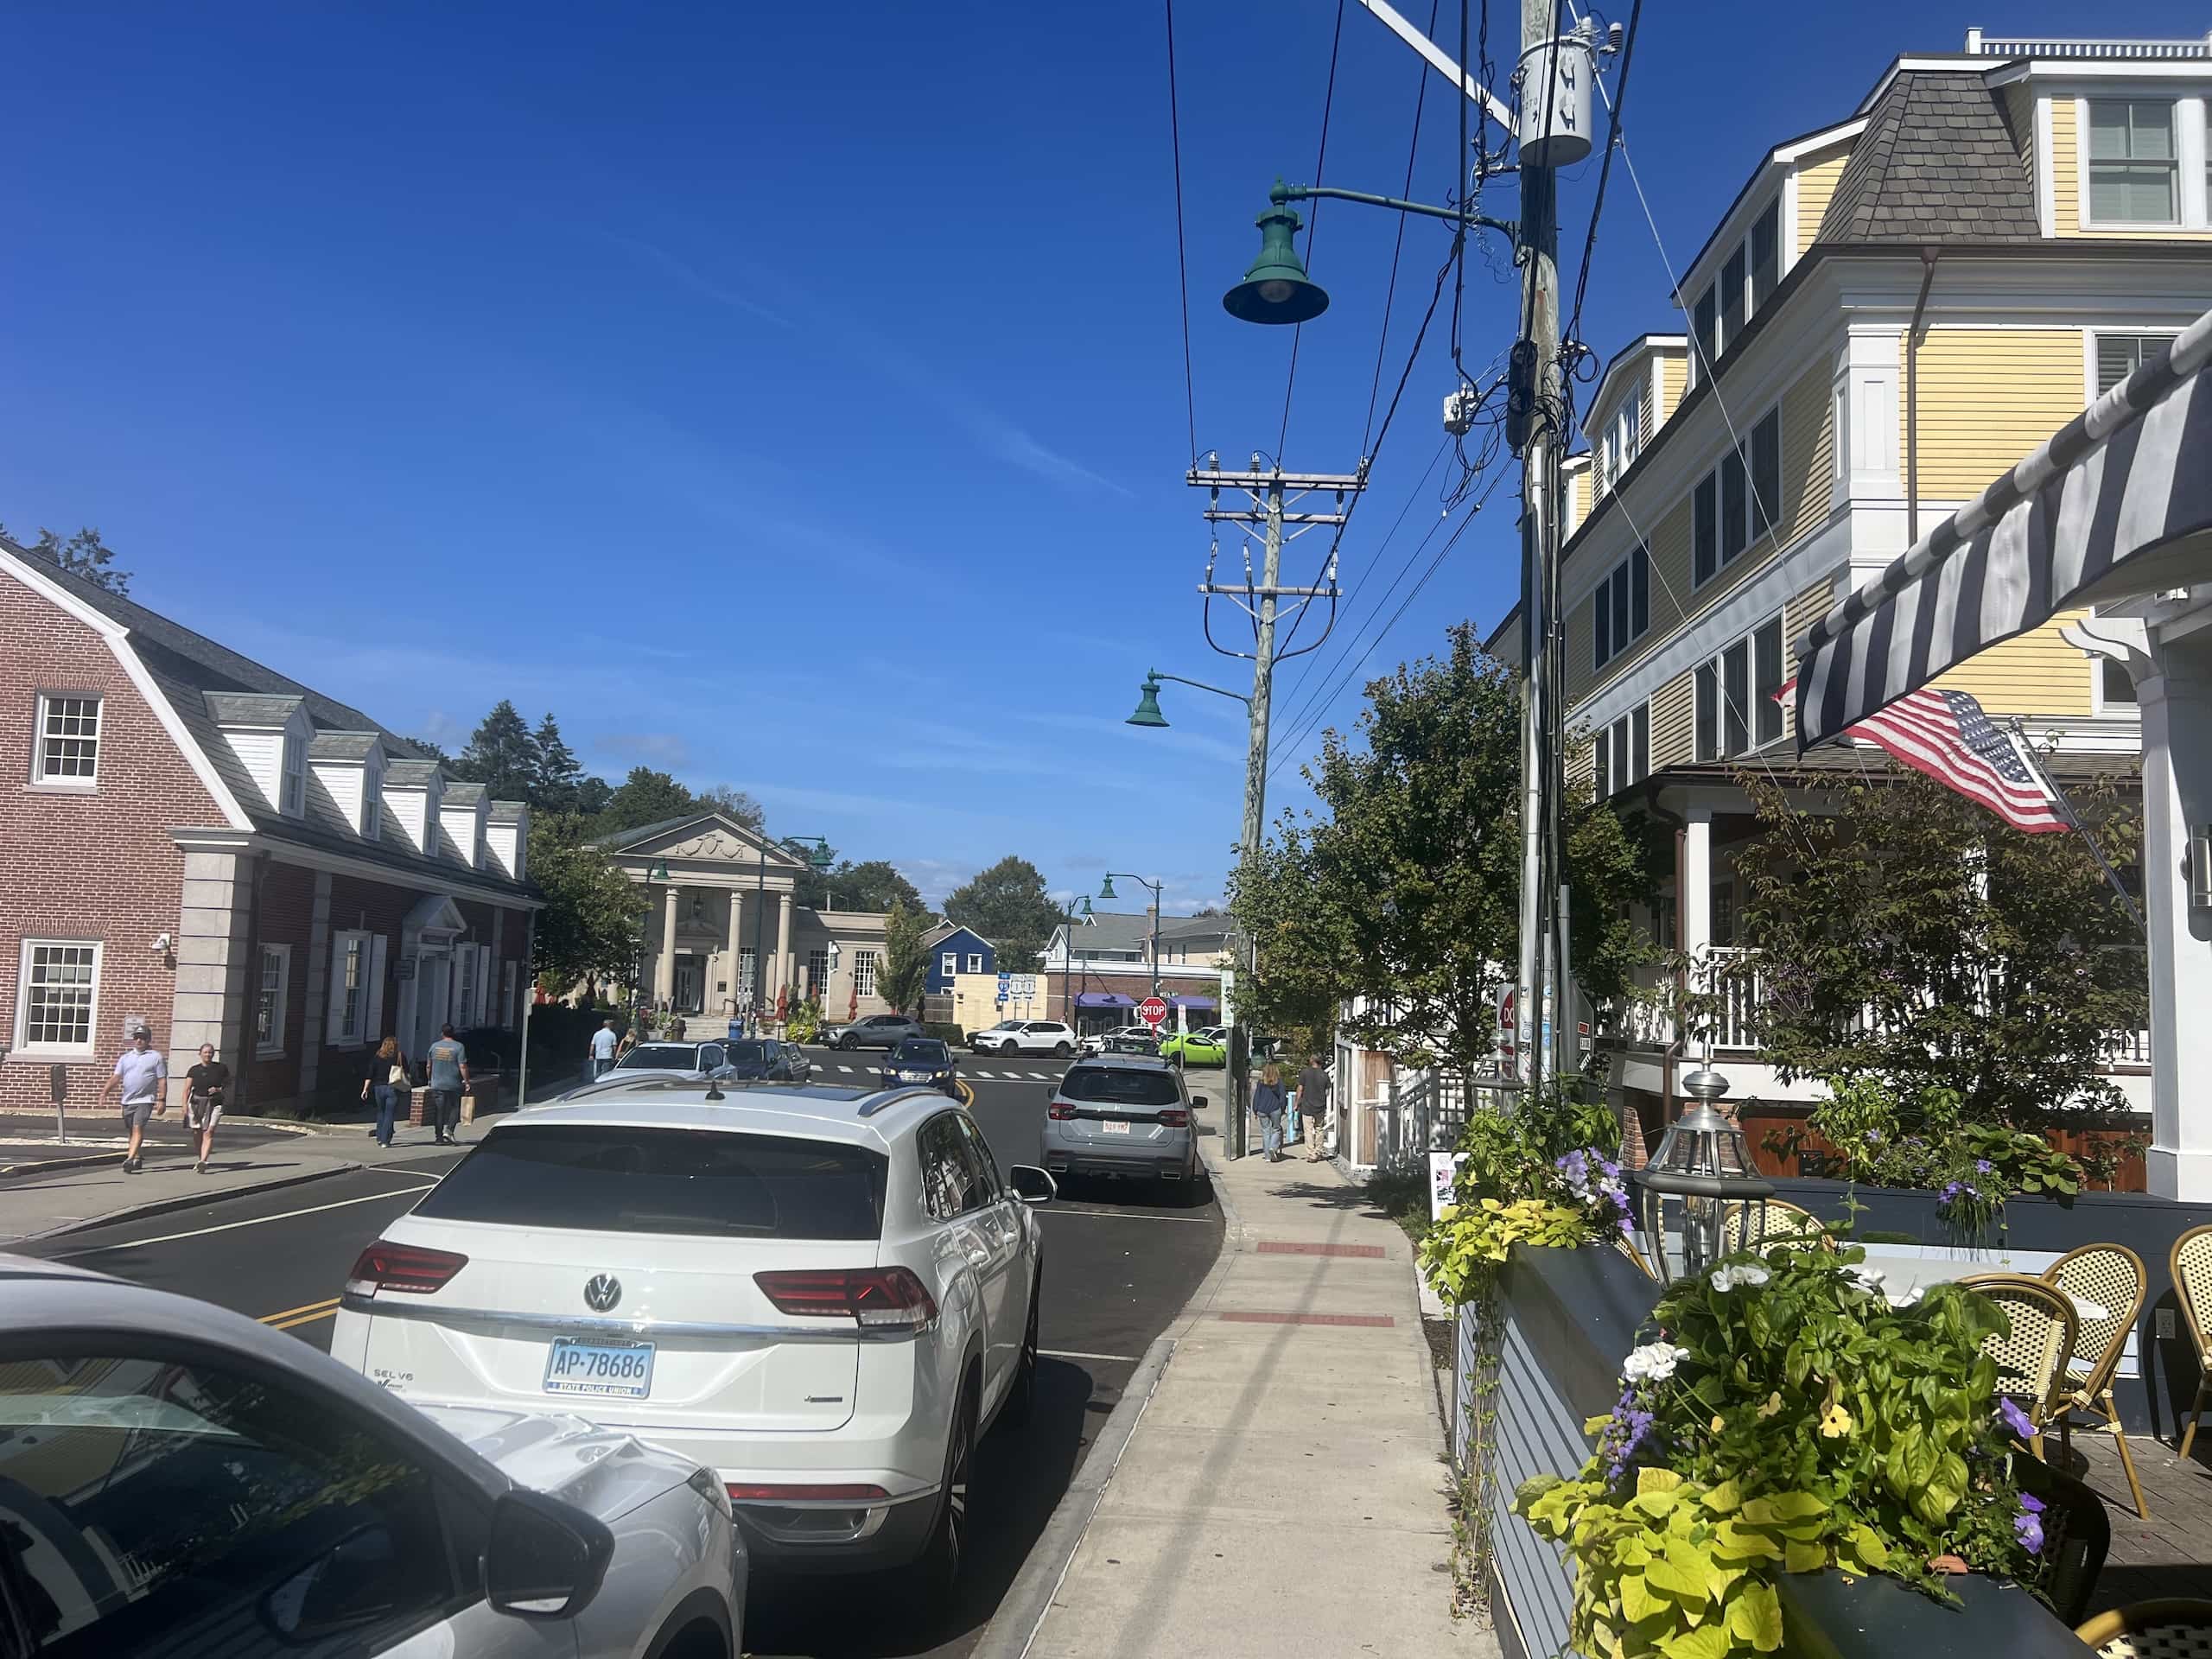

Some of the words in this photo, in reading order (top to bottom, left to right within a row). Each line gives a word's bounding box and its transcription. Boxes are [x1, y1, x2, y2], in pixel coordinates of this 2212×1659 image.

[1142, 1005, 1165, 1016] STOP
[374, 1369, 396, 1378] SEL
[398, 1372, 414, 1381] V6
[559, 1382, 581, 1391] STATE
[582, 1384, 607, 1394] POLICE
[608, 1386, 632, 1395] UNION
